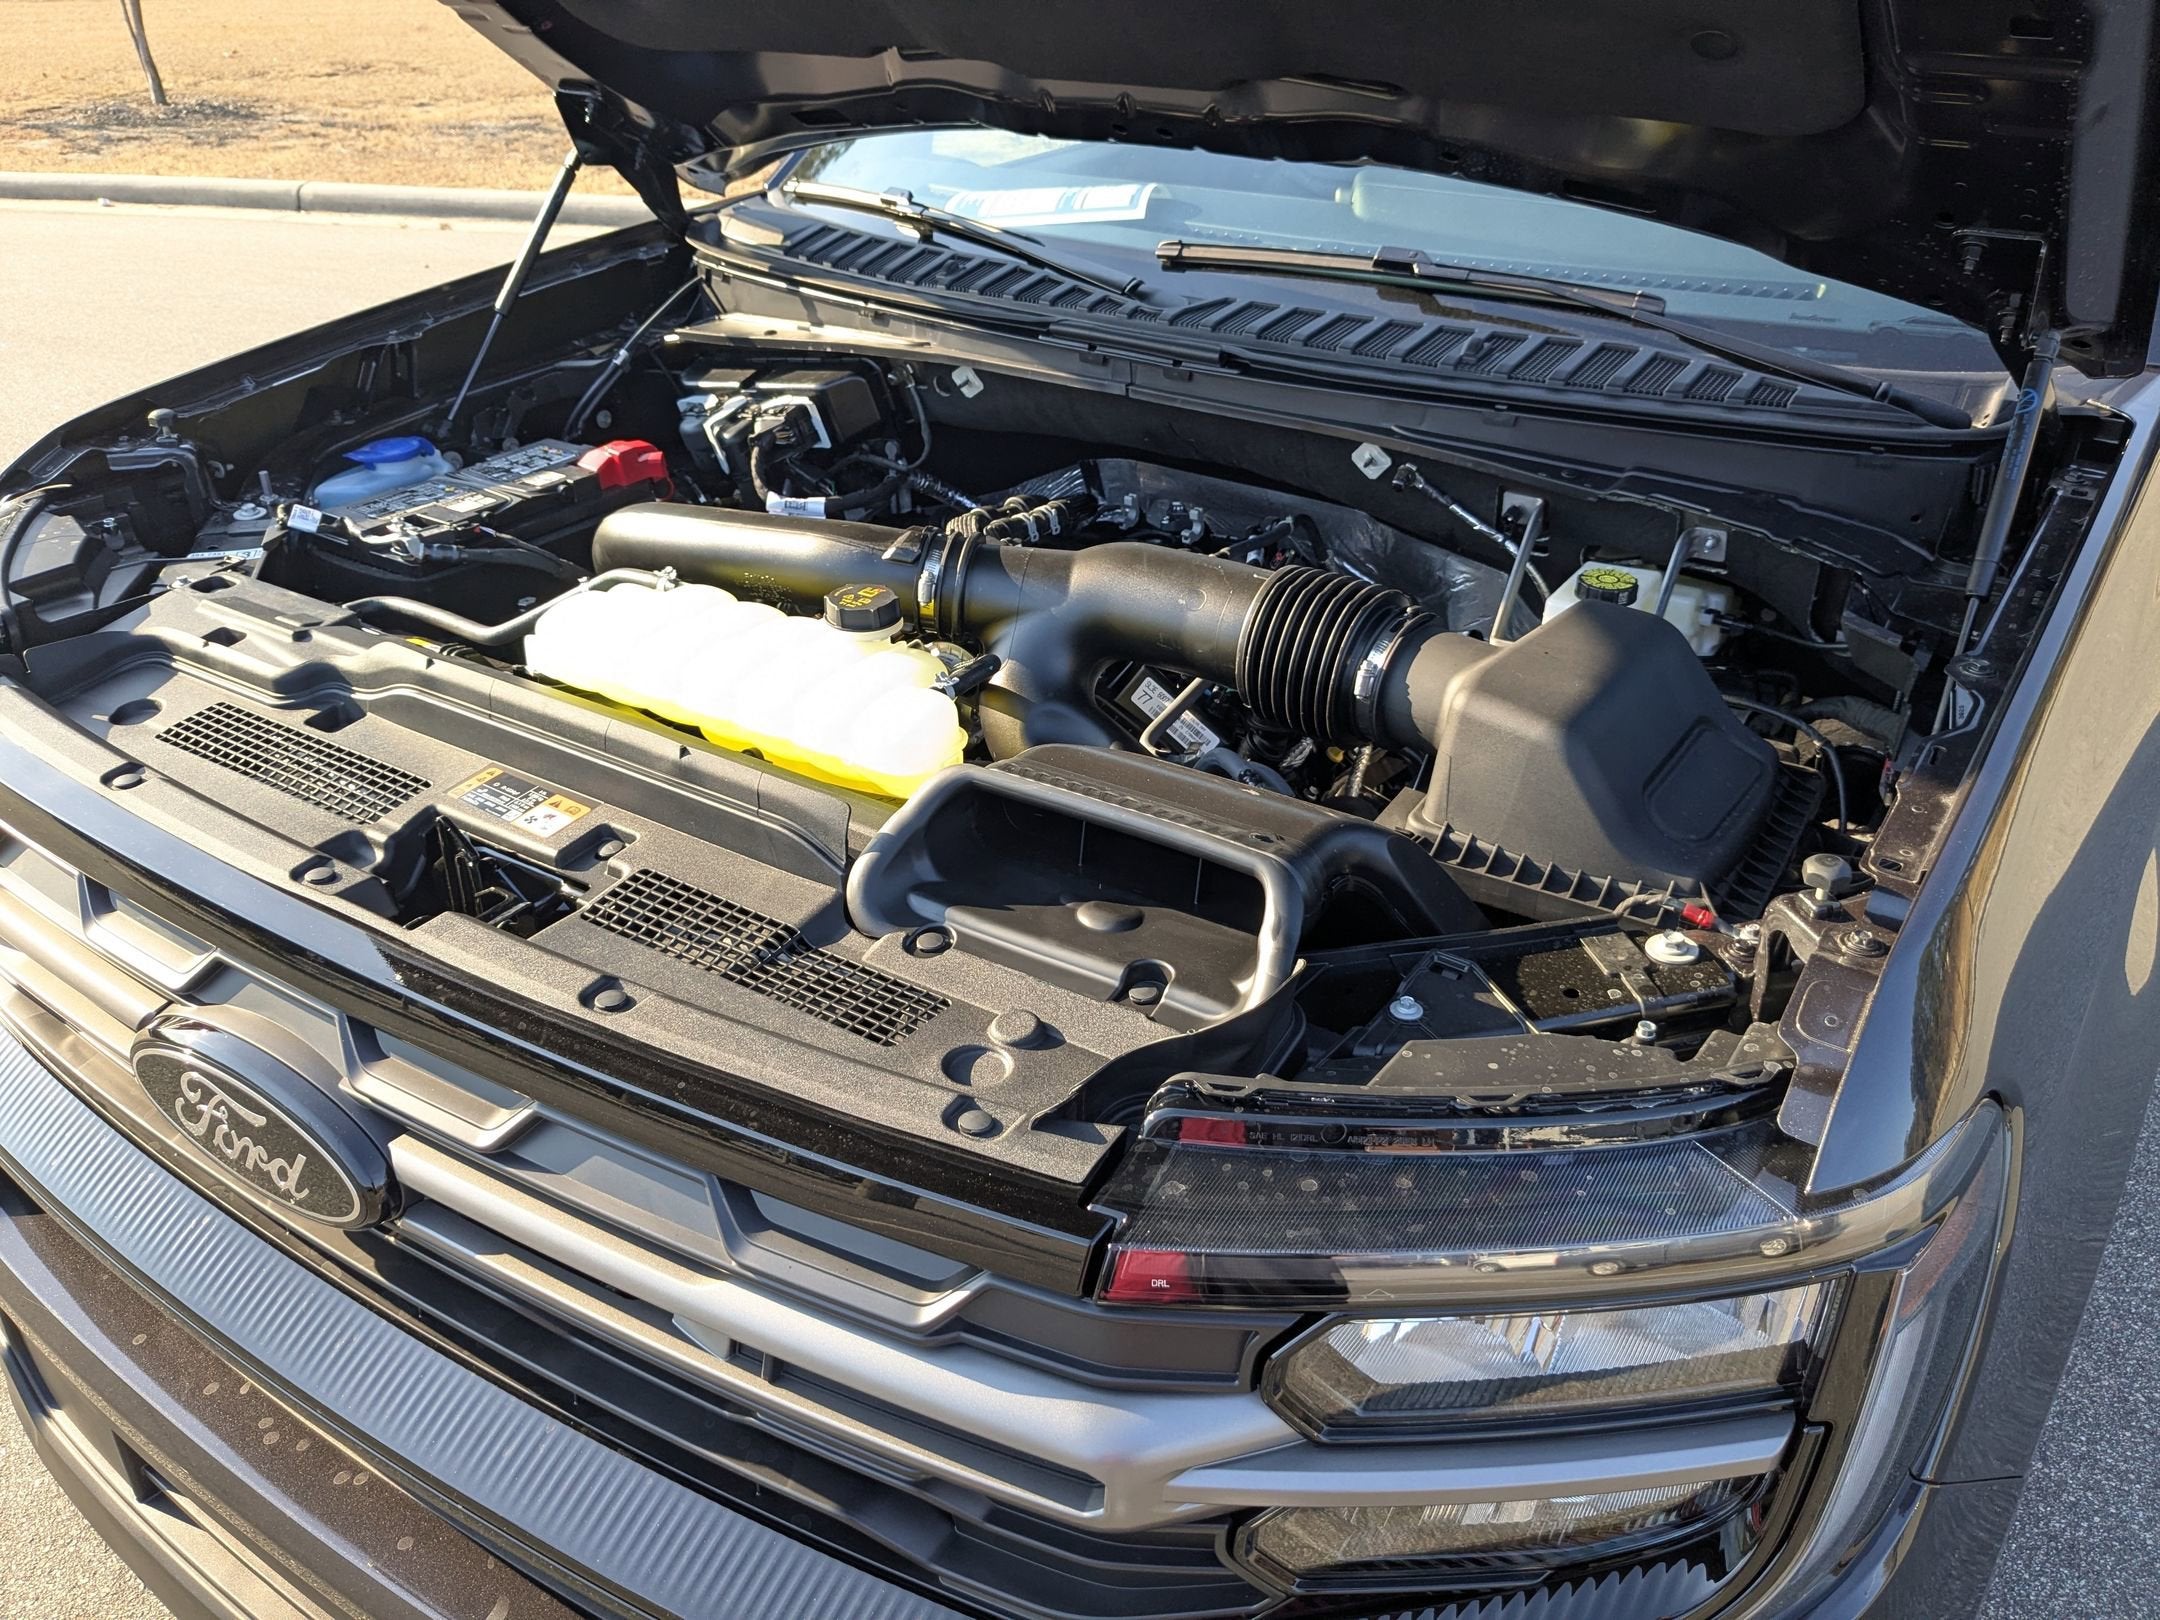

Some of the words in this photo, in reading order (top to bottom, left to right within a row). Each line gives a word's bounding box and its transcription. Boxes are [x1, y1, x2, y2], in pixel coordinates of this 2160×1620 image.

[1137, 689, 1153, 705] 77
[174, 1071, 310, 1200] Ford
[1151, 1278, 1170, 1288] DRL
